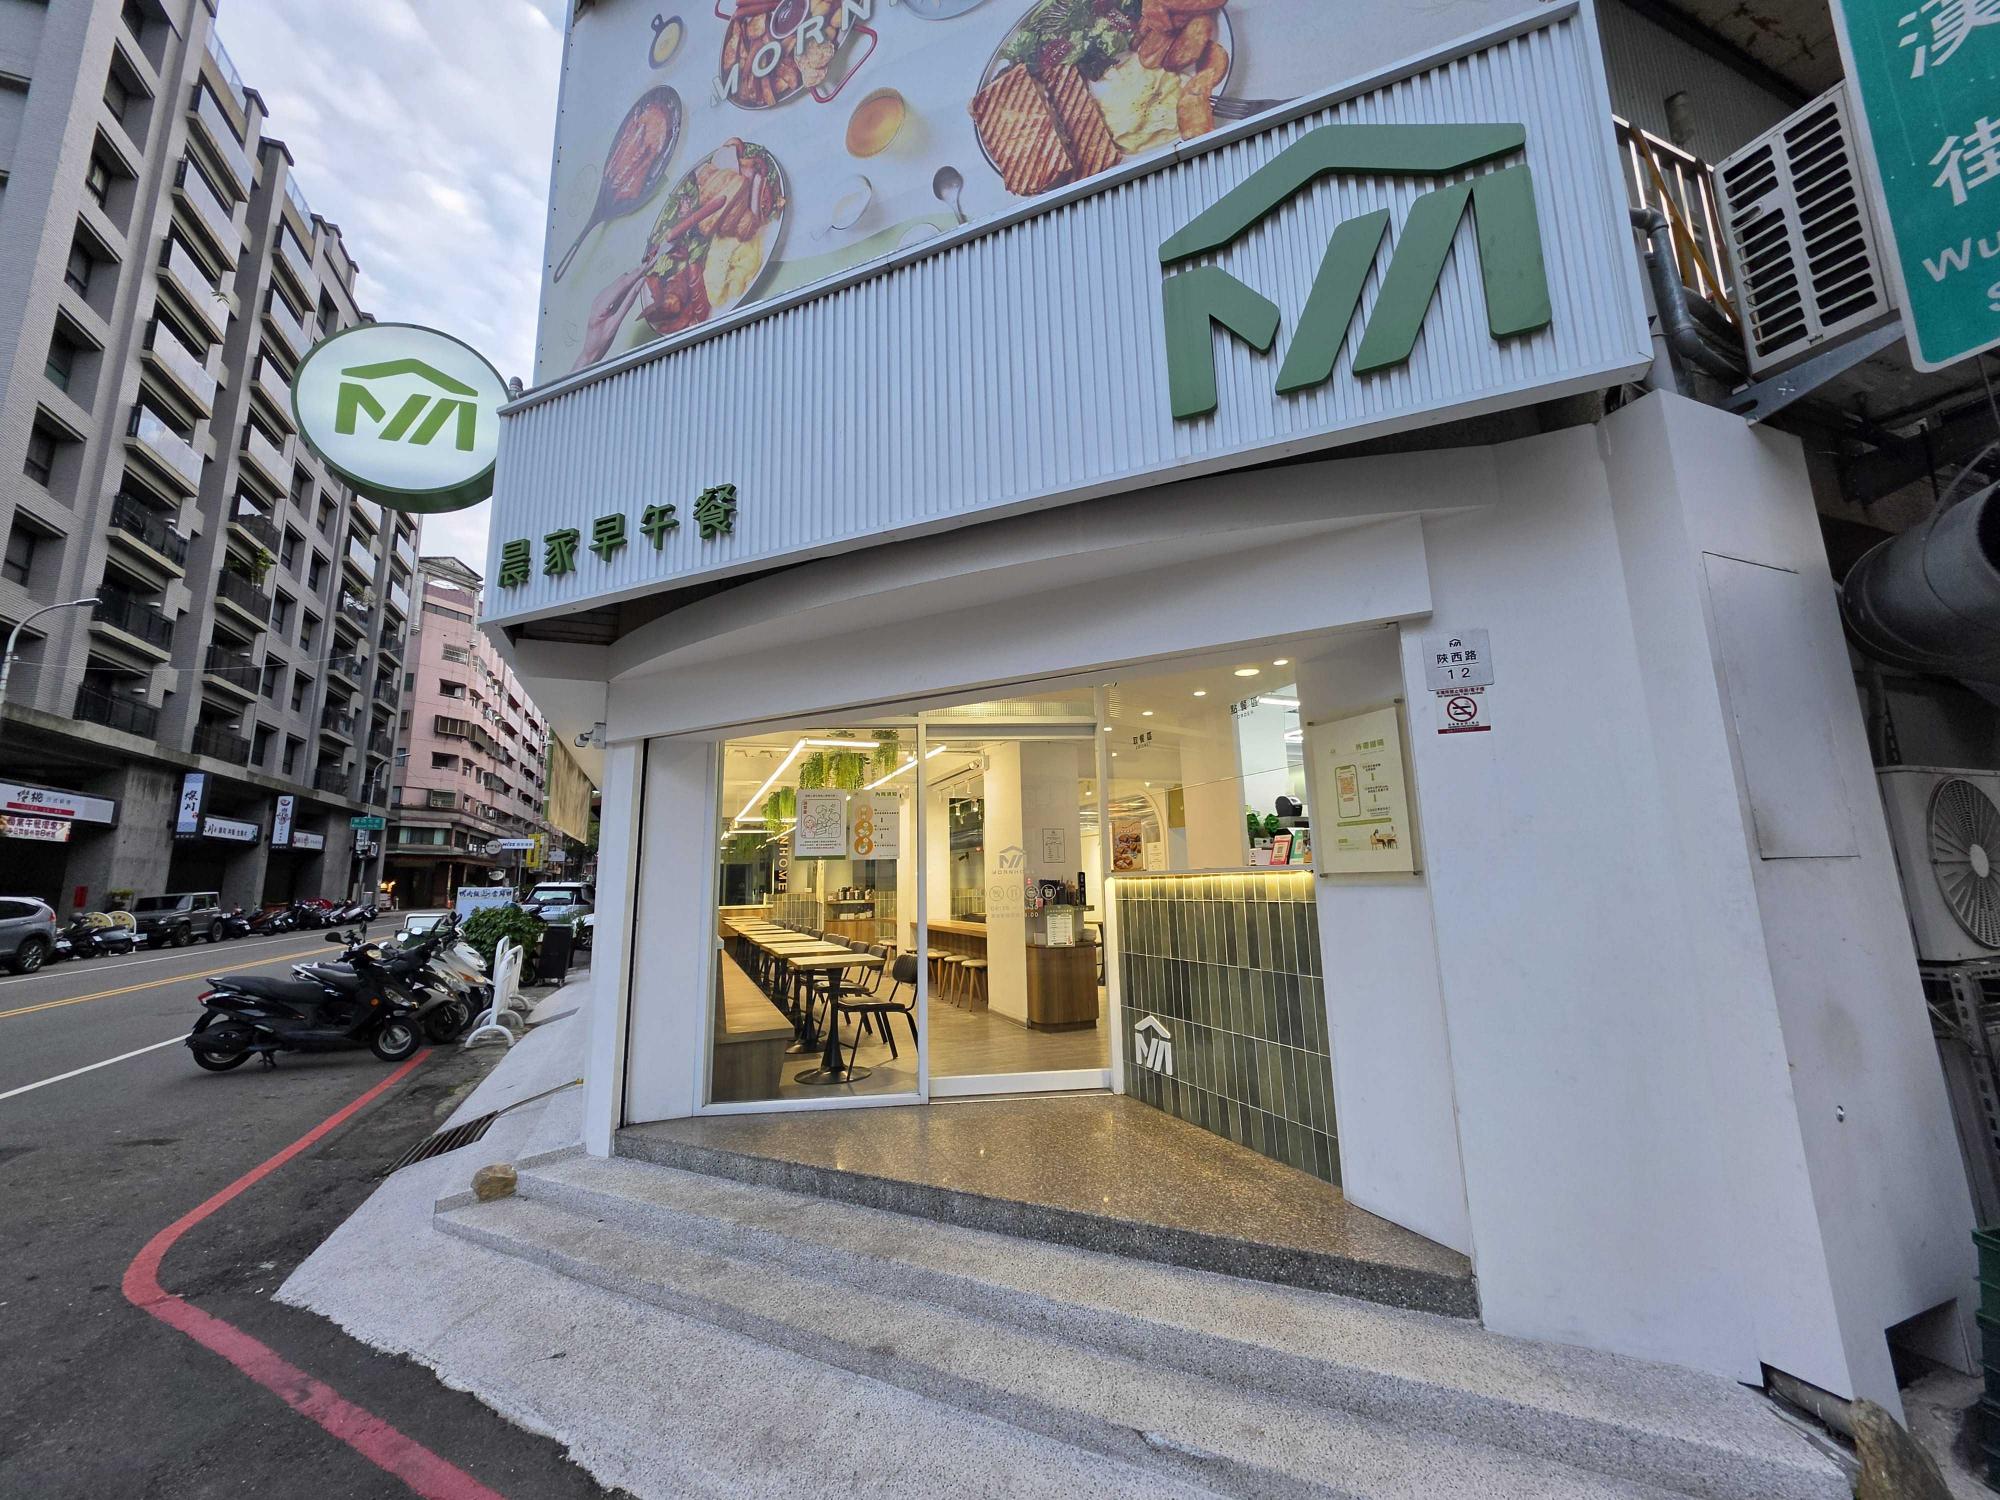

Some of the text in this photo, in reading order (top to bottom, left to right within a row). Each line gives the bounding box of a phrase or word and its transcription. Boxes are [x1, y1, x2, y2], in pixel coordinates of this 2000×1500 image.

[497, 482, 738, 590] 晨家早午餐
[1436, 650, 1477, 665] 陝西路
